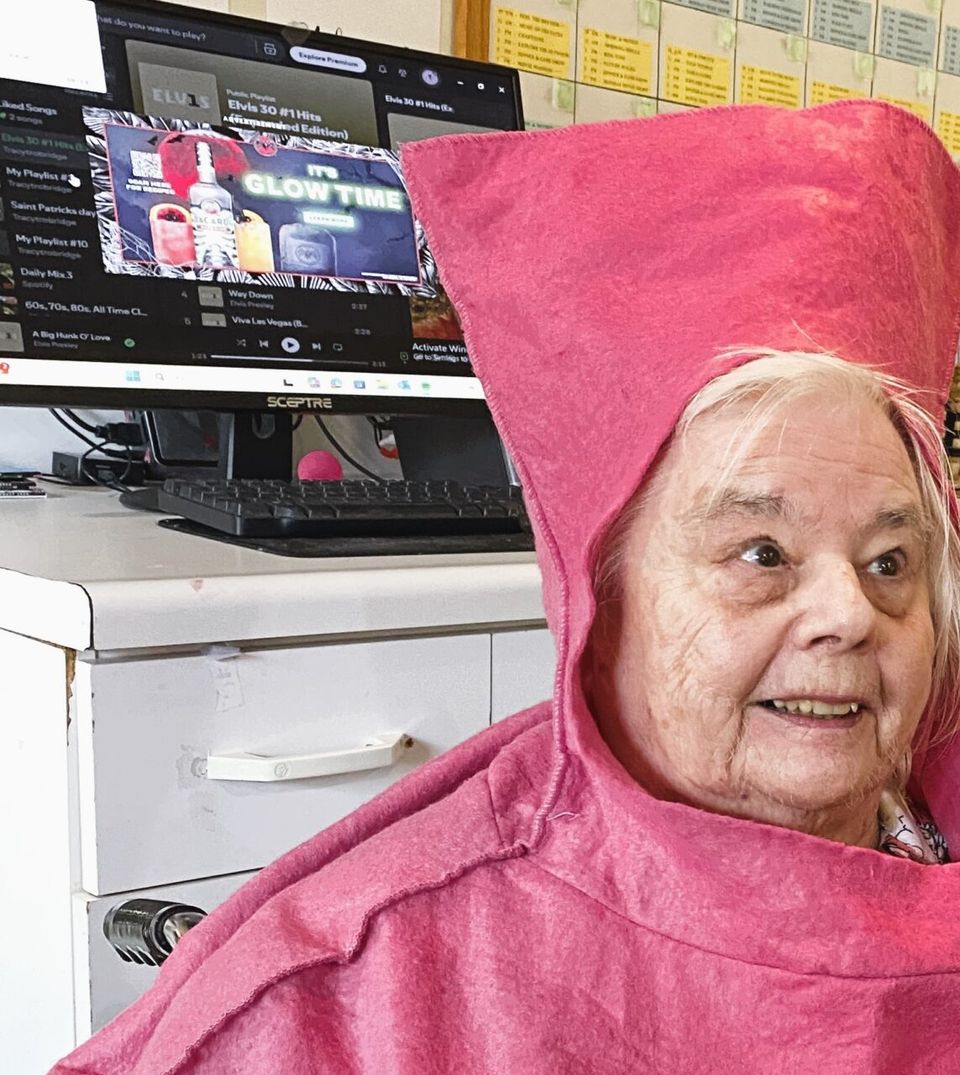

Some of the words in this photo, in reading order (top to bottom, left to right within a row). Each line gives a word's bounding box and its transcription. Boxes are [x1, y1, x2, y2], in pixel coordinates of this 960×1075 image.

[114, 18, 127, 28] do
[128, 21, 145, 31] you
[147, 24, 170, 35] want
[171, 28, 182, 37] to
[182, 31, 206, 42] play?
[298, 51, 326, 63] Explore
[327, 55, 359, 68] Premium
[25, 103, 58, 116] Songs
[385, 94, 402, 105] Elvis
[403, 97, 414, 106] 30
[425, 101, 440, 111] Hits
[228, 99, 258, 113] Elvis
[259, 103, 277, 116] 30
[279, 107, 296, 120] #1
[298, 109, 322, 123] Hits
[301, 123, 349, 141] Edition)
[5, 166, 21, 178] My
[23, 168, 59, 181] Playlist
[243, 173, 330, 201] GLOW
[334, 184, 403, 210] TIME
[10, 200, 37, 212] Saint
[38, 203, 78, 215] Patricks
[78, 208, 96, 219] day
[15, 233, 32, 245] My
[33, 235, 68, 248] Playlist
[70, 239, 89, 249] #10
[20, 267, 46, 279] Daily
[47, 269, 65, 278] Mix
[66, 270, 74, 279] 3
[228, 288, 248, 301] Way
[248, 290, 274, 300] Down
[93, 305, 105, 315] All
[107, 306, 130, 316] Time
[232, 315, 251, 325] Viva
[251, 317, 267, 326] Las
[267, 318, 293, 329] Vegas
[32, 330, 39, 338] A
[40, 330, 55, 341] Big
[56, 331, 78, 340] Hunk
[90, 333, 112, 342] Love
[412, 342, 447, 353] Activate
[448, 344, 467, 353] Win
[267, 396, 333, 409] SCEPTRE
